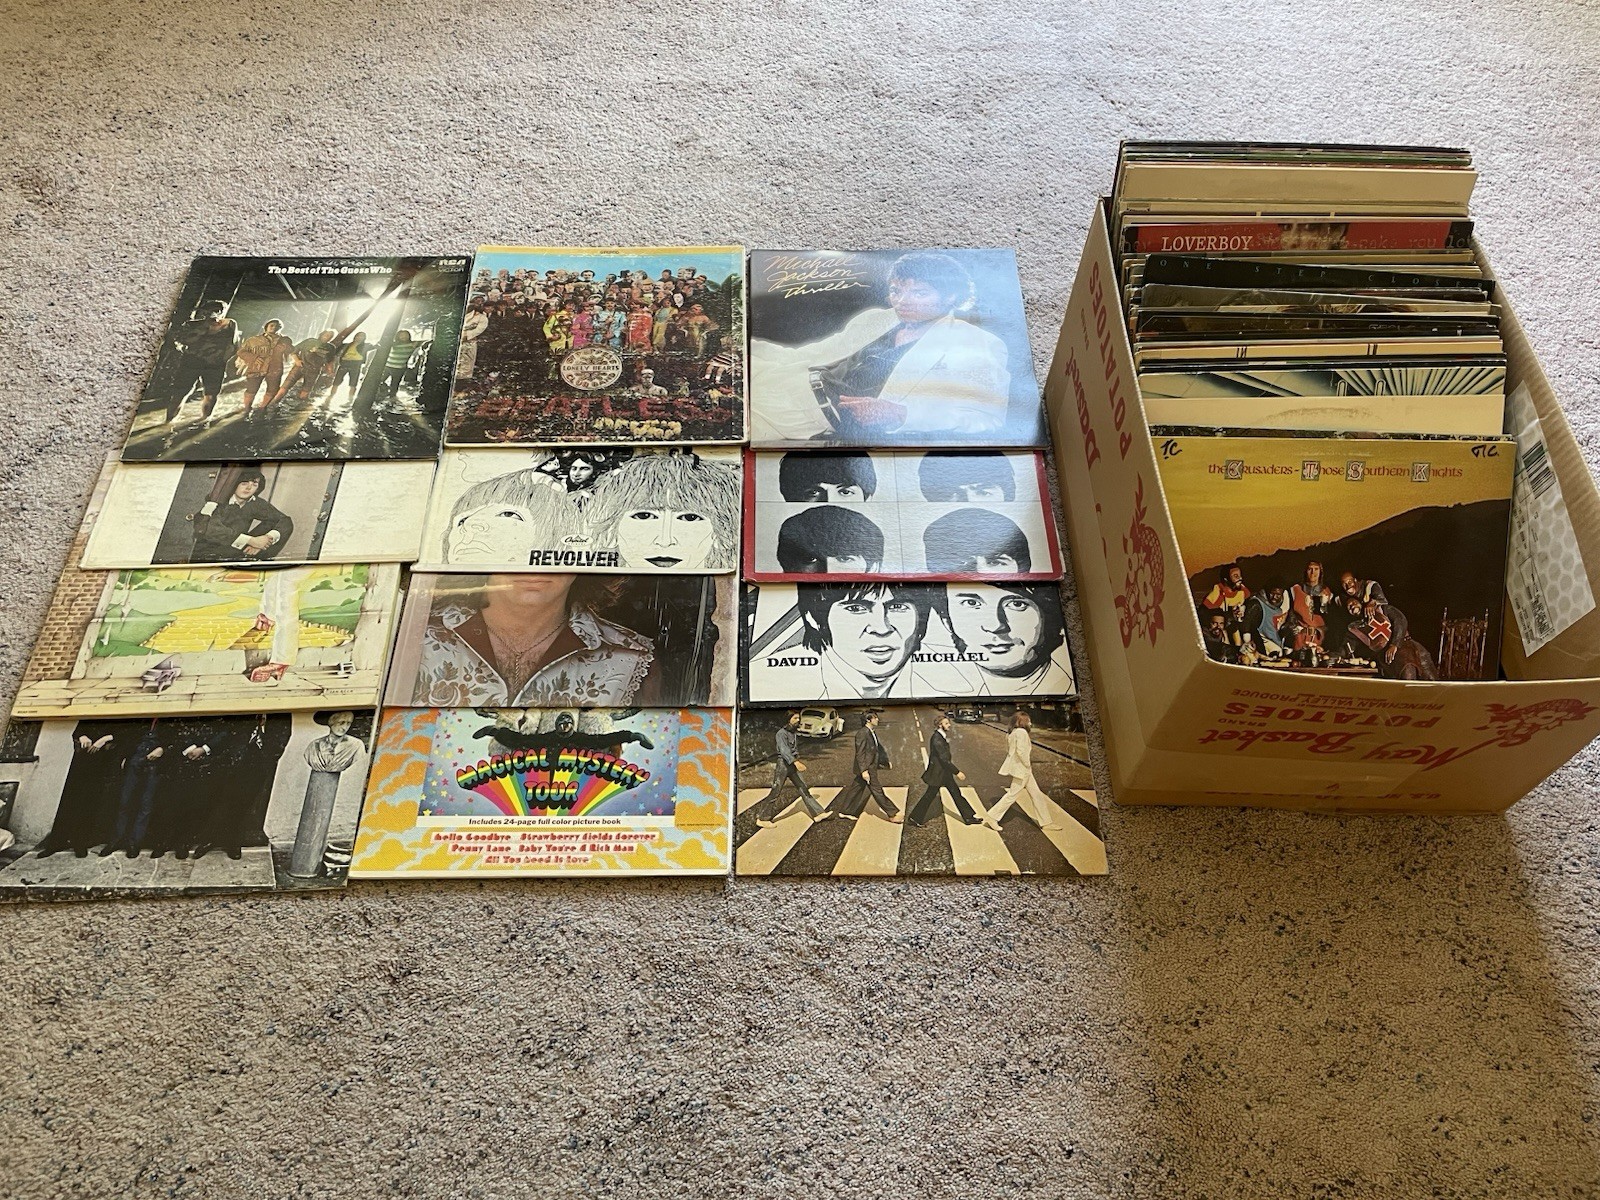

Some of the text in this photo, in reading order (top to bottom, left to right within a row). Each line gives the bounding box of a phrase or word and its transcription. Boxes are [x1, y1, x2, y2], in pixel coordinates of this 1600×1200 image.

[1160, 235, 1253, 252] LOVERBOY
[268, 266, 393, 274] The Best of The Guess Who
[763, 254, 862, 273] Michael
[1160, 258, 1213, 270] ONE
[1255, 264, 1326, 278] STEP
[766, 268, 868, 293] Jackson
[1089, 260, 1132, 461] POTATOES
[1208, 463, 1225, 475] the
[1301, 460, 1345, 481] Those
[1346, 461, 1410, 482] Southern
[1411, 462, 1463, 482] Knights
[529, 549, 620, 567] REVOLVER
[767, 656, 819, 668] DAVID
[911, 651, 989, 663] MICHAEL
[1231, 688, 1299, 703] PRODUCE
[1301, 693, 1355, 707] VALLEY
[1356, 696, 1445, 710] FRENCHMAN
[1218, 718, 1267, 727] BRAND
[1223, 702, 1441, 728] POTATOES
[1198, 730, 1480, 772] May Basket
[456, 747, 651, 790] MAGICAL MYSTERY
[522, 780, 579, 803] TOUR
[503, 818, 536, 826] 24-page
[572, 818, 600, 826] picture
[465, 833, 511, 843] Goodbye
[520, 833, 580, 842] Strawberry
[451, 844, 484, 853] Penny
[486, 844, 511, 852] Lane
[518, 844, 542, 854] Baby
[545, 844, 577, 852] You're
[589, 843, 610, 852] Rich
[613, 844, 635, 852] Man
[485, 855, 590, 863] All You Need Is Love
